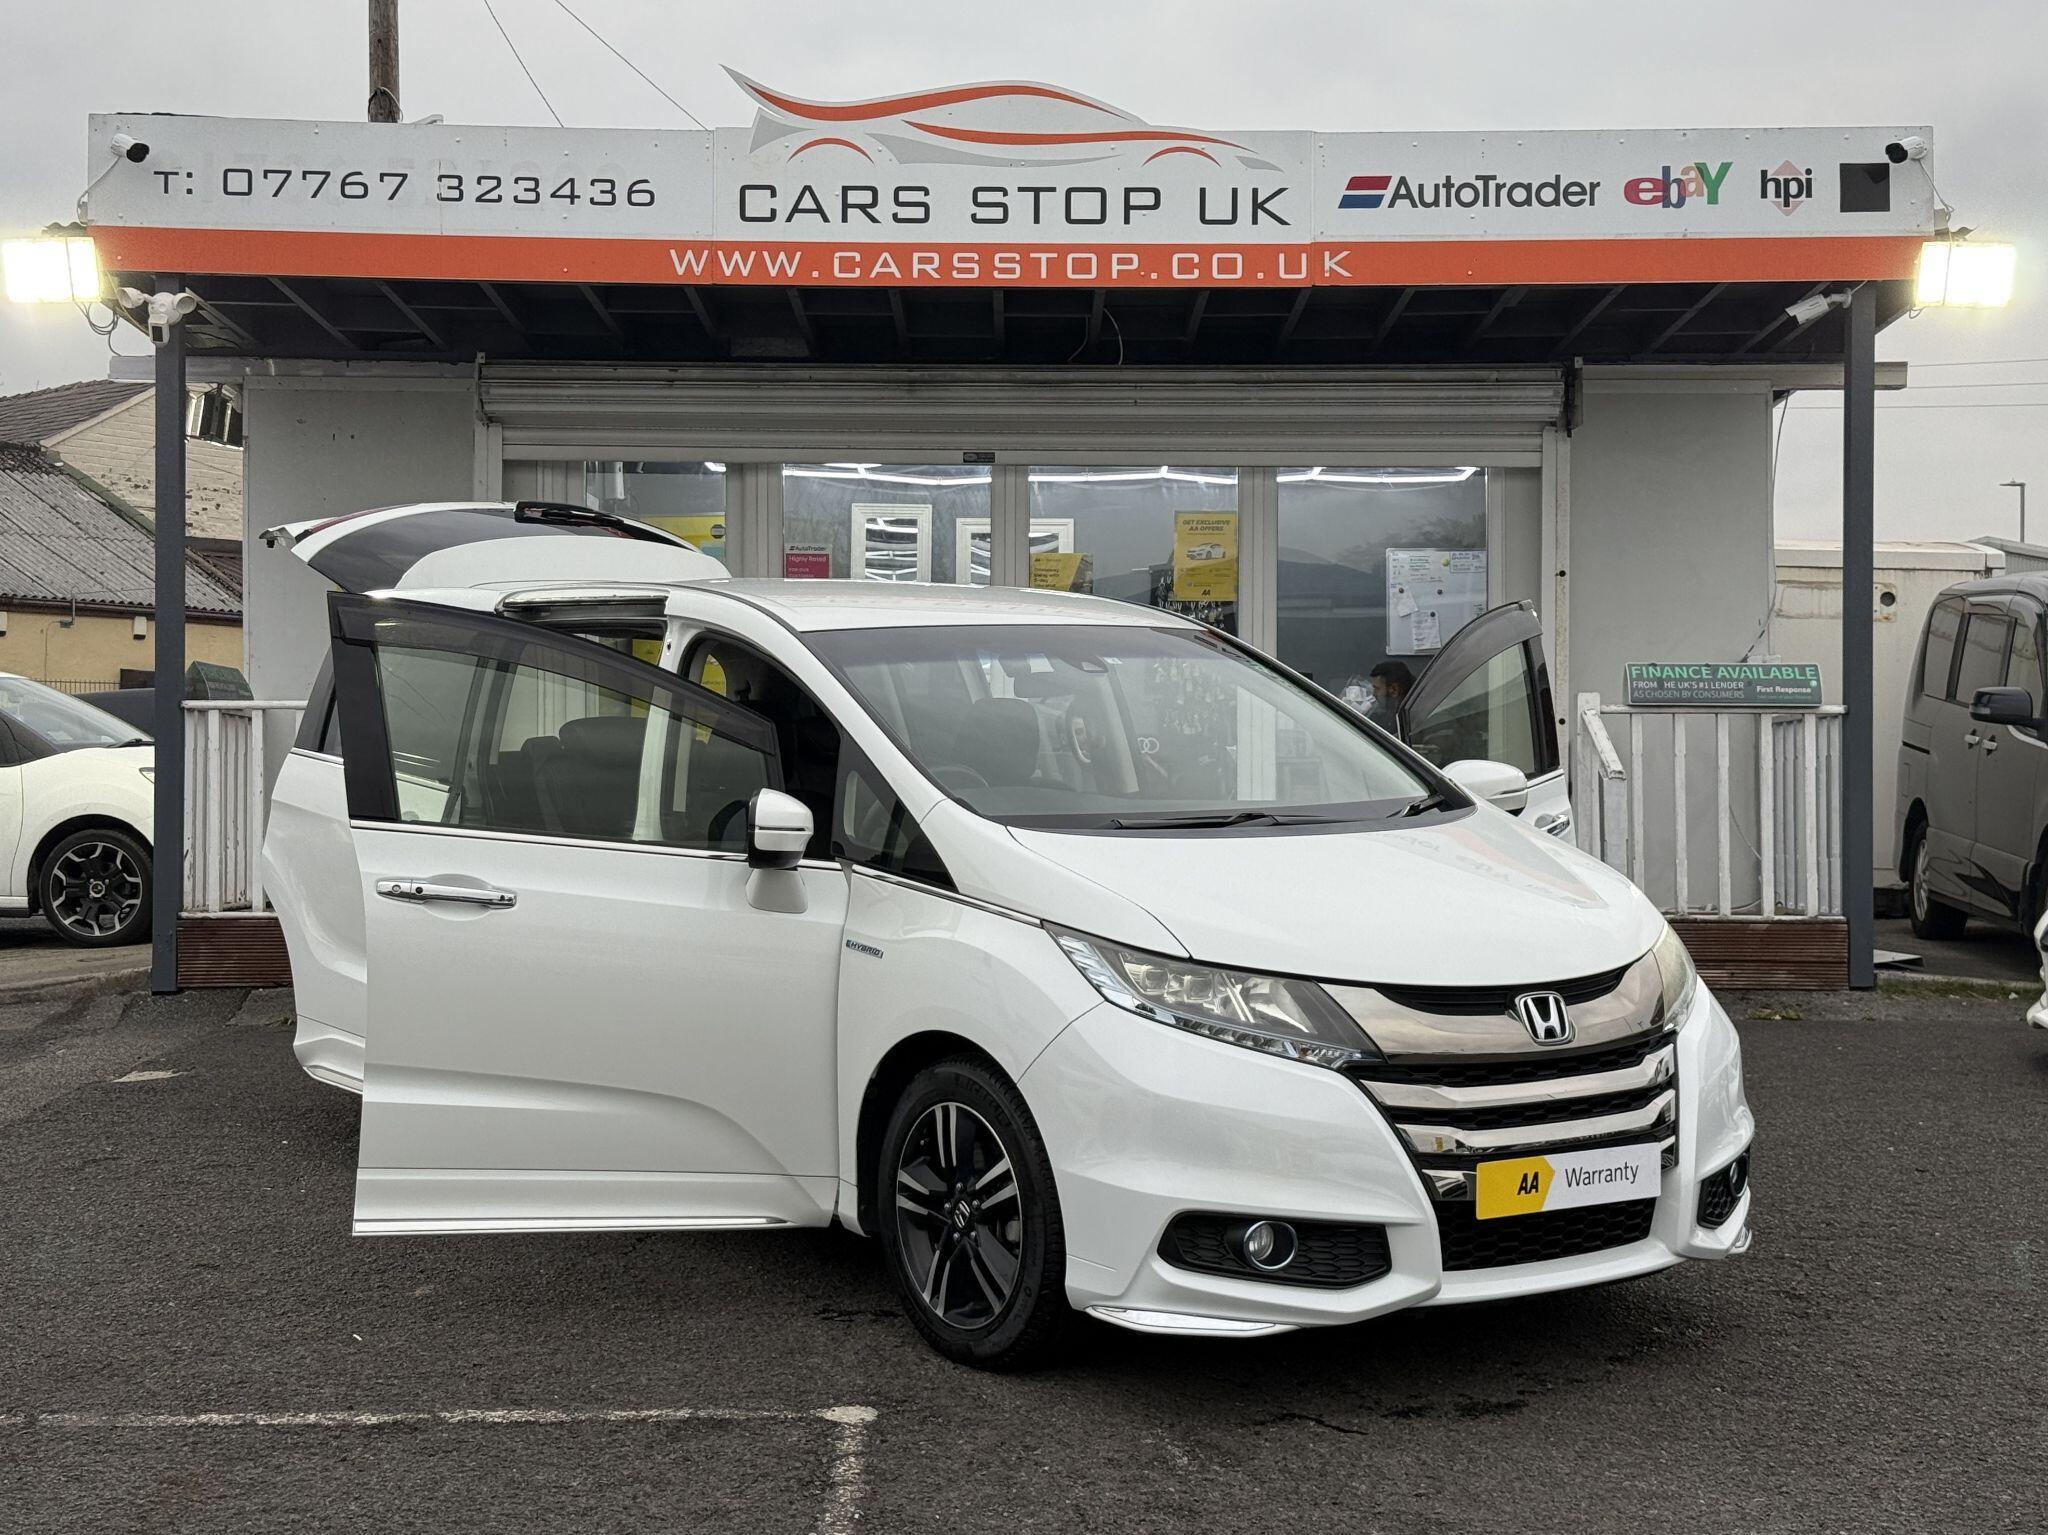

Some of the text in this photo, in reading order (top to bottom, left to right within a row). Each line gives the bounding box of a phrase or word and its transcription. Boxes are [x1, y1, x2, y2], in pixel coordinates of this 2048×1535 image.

[153, 168, 656, 207] T: 07767 323436
[1387, 174, 1601, 208] AutoTrader
[1760, 168, 1813, 203] hpi
[739, 184, 1291, 226] CARS STOP UK
[669, 249, 1353, 280] WWW.CARSSTOP.CO.UK
[1631, 666, 1818, 680] FINANCE AVAILABLE
[1632, 681, 1658, 689] FROM
[1710, 681, 1745, 689] LENDER
[1632, 690, 1745, 699] AS CHOSEN BY CONSUMERS
[1775, 686, 1812, 694] Response
[850, 942, 881, 956] HYBRID
[1517, 1161, 1639, 1196] AA Warranty
